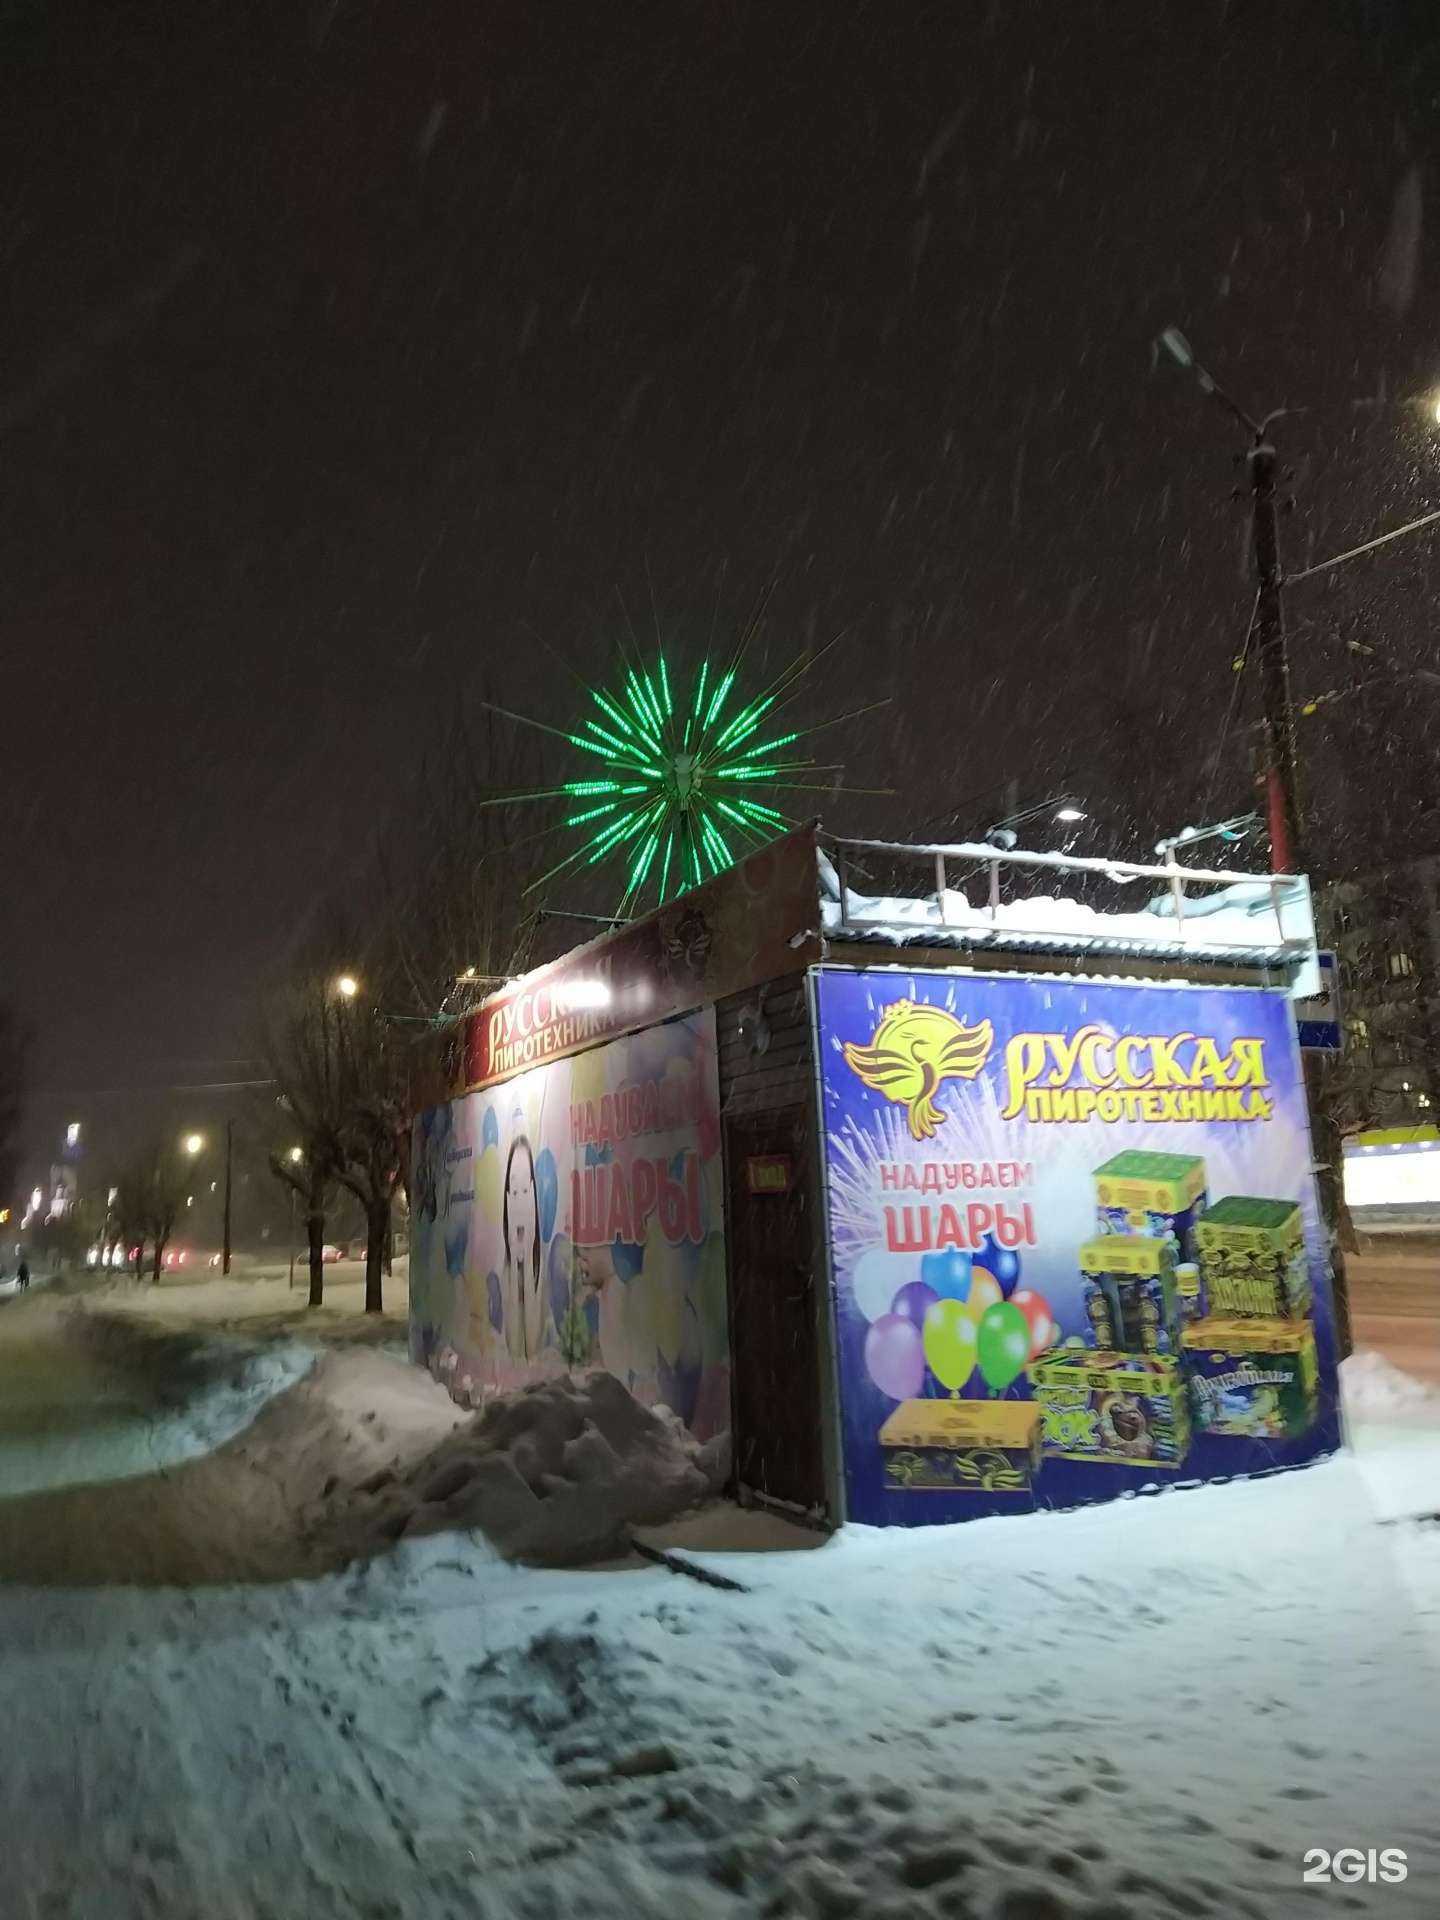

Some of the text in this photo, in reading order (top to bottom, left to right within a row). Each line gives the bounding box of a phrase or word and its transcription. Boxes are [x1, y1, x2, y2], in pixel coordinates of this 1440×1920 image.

[486, 954, 614, 1076] РУССКЯ
[493, 1005, 616, 1074] ПИРОТЕХНИКА
[1002, 1024, 1271, 1120] РУССКАЯ
[1026, 1086, 1275, 1123] ПИРОТЕХНИКА
[571, 1152, 705, 1244] ШАРЫ
[880, 1161, 1035, 1195] НАДУВАЕМ
[883, 1203, 1037, 1253] ШАРЫ
